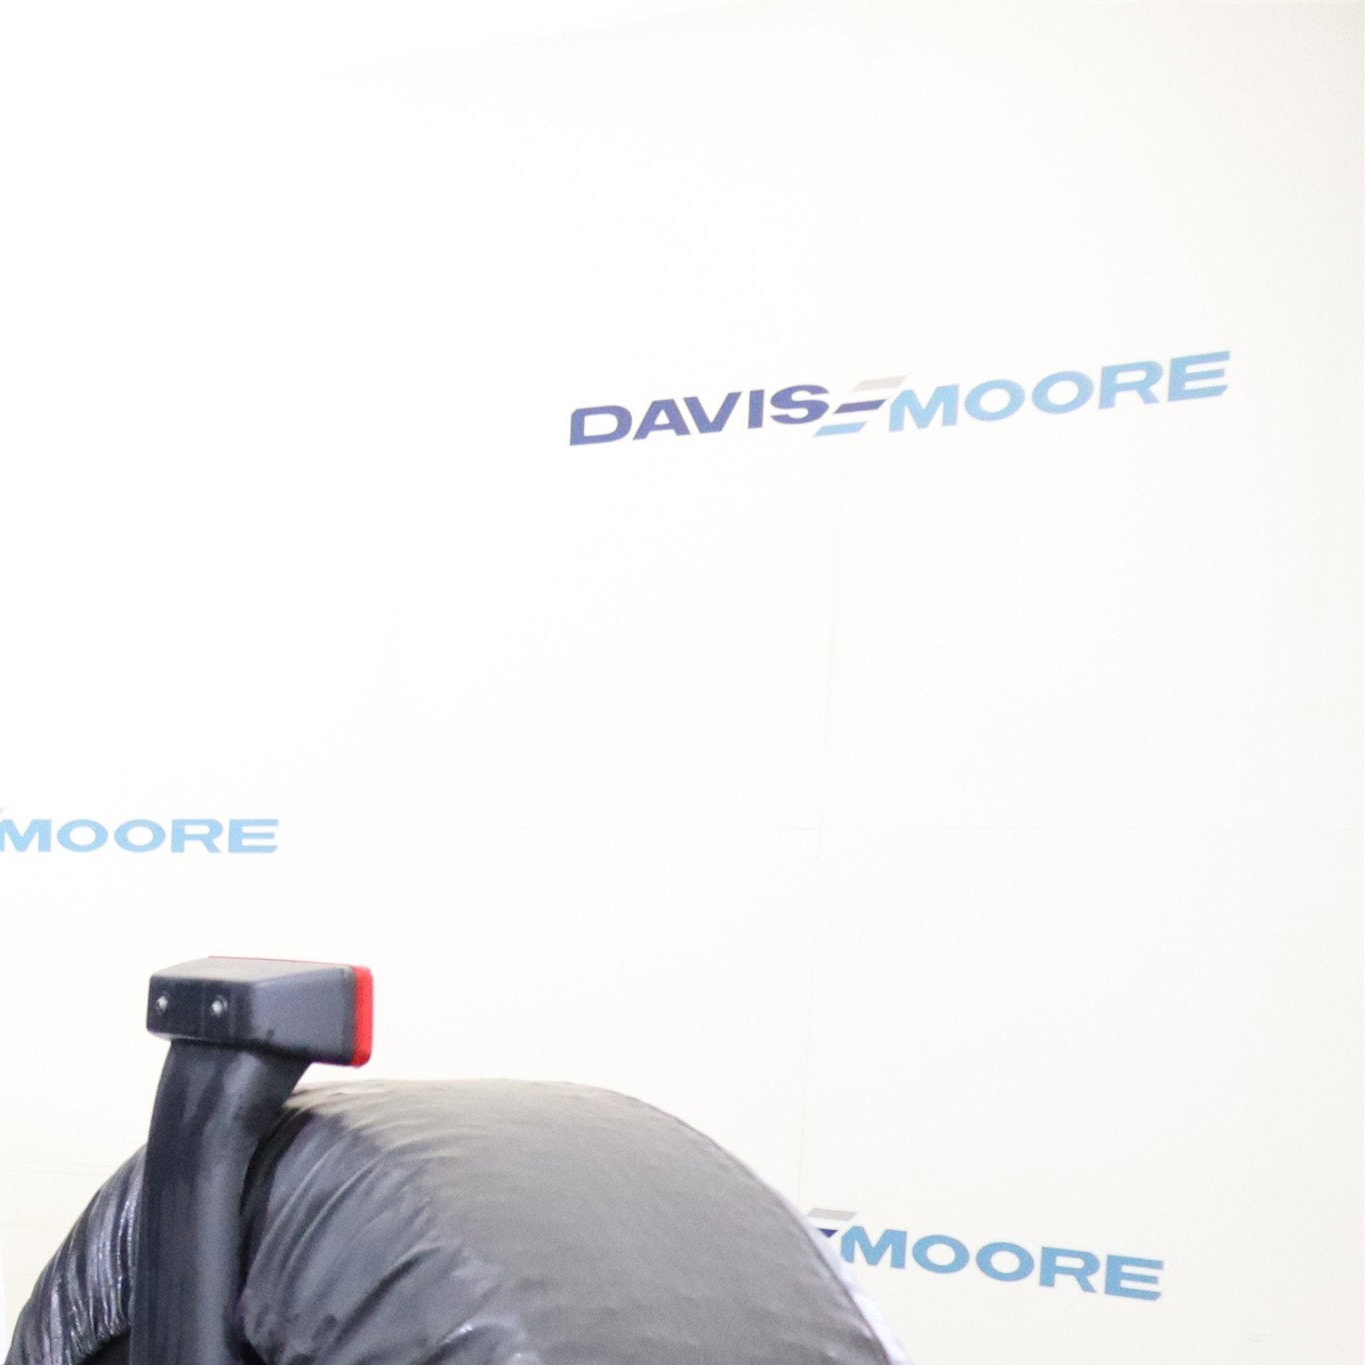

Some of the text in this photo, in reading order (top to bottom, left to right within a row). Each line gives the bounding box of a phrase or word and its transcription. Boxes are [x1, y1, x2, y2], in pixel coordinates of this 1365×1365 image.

[570, 351, 1231, 446] DAVIS MOORE
[840, 1225, 1164, 1302] MOORE
